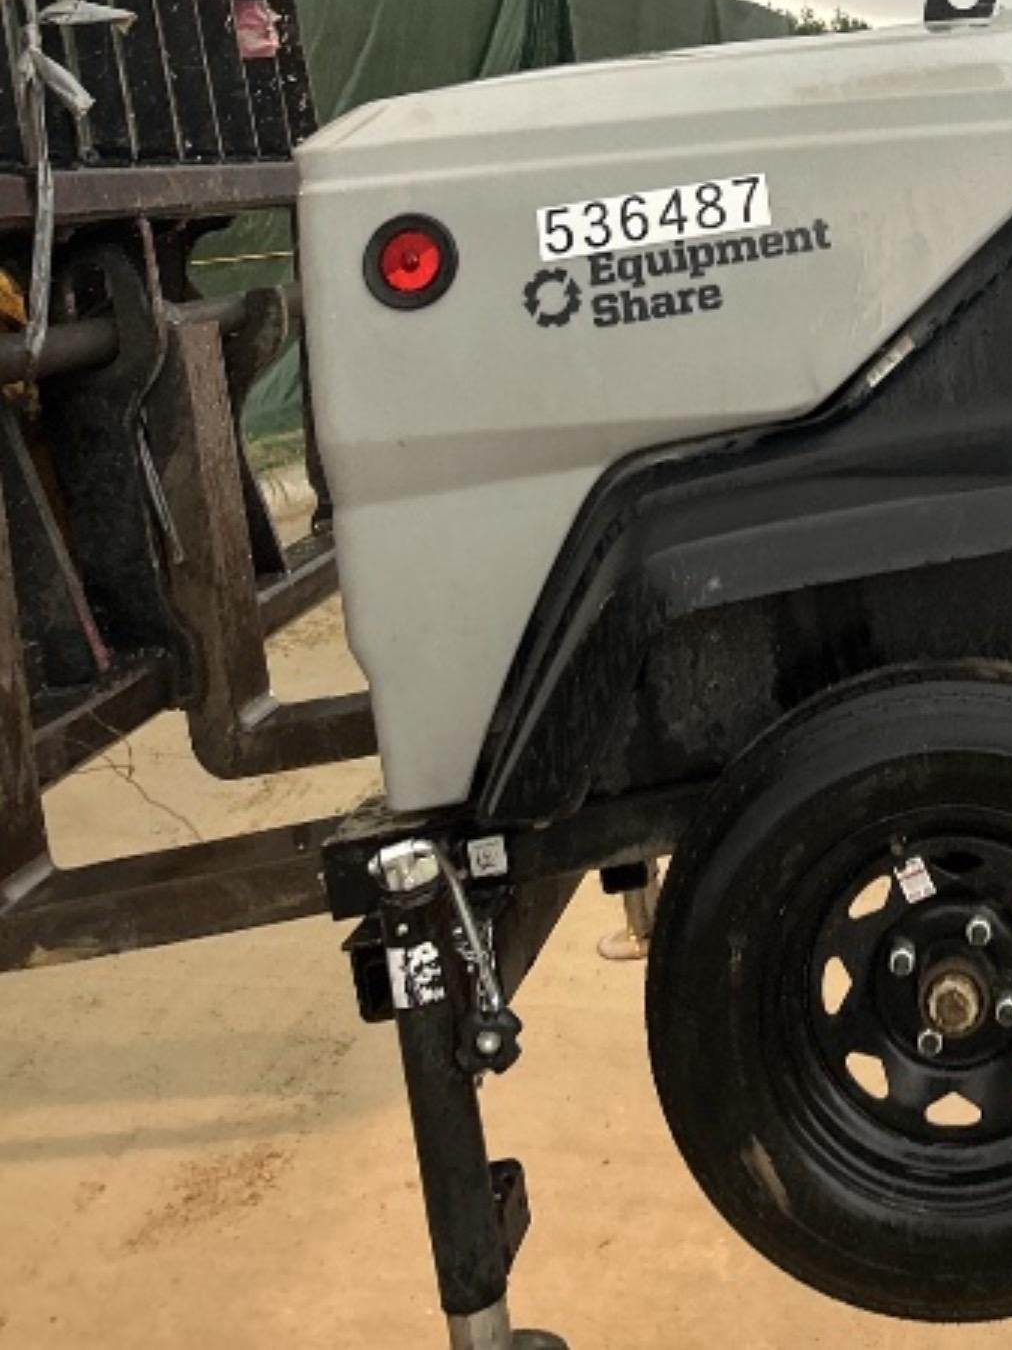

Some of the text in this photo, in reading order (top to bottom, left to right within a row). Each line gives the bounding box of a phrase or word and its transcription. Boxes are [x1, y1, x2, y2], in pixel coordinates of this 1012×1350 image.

[545, 176, 761, 254] 536487
[588, 218, 831, 287] Equipment
[591, 284, 723, 327] Share
